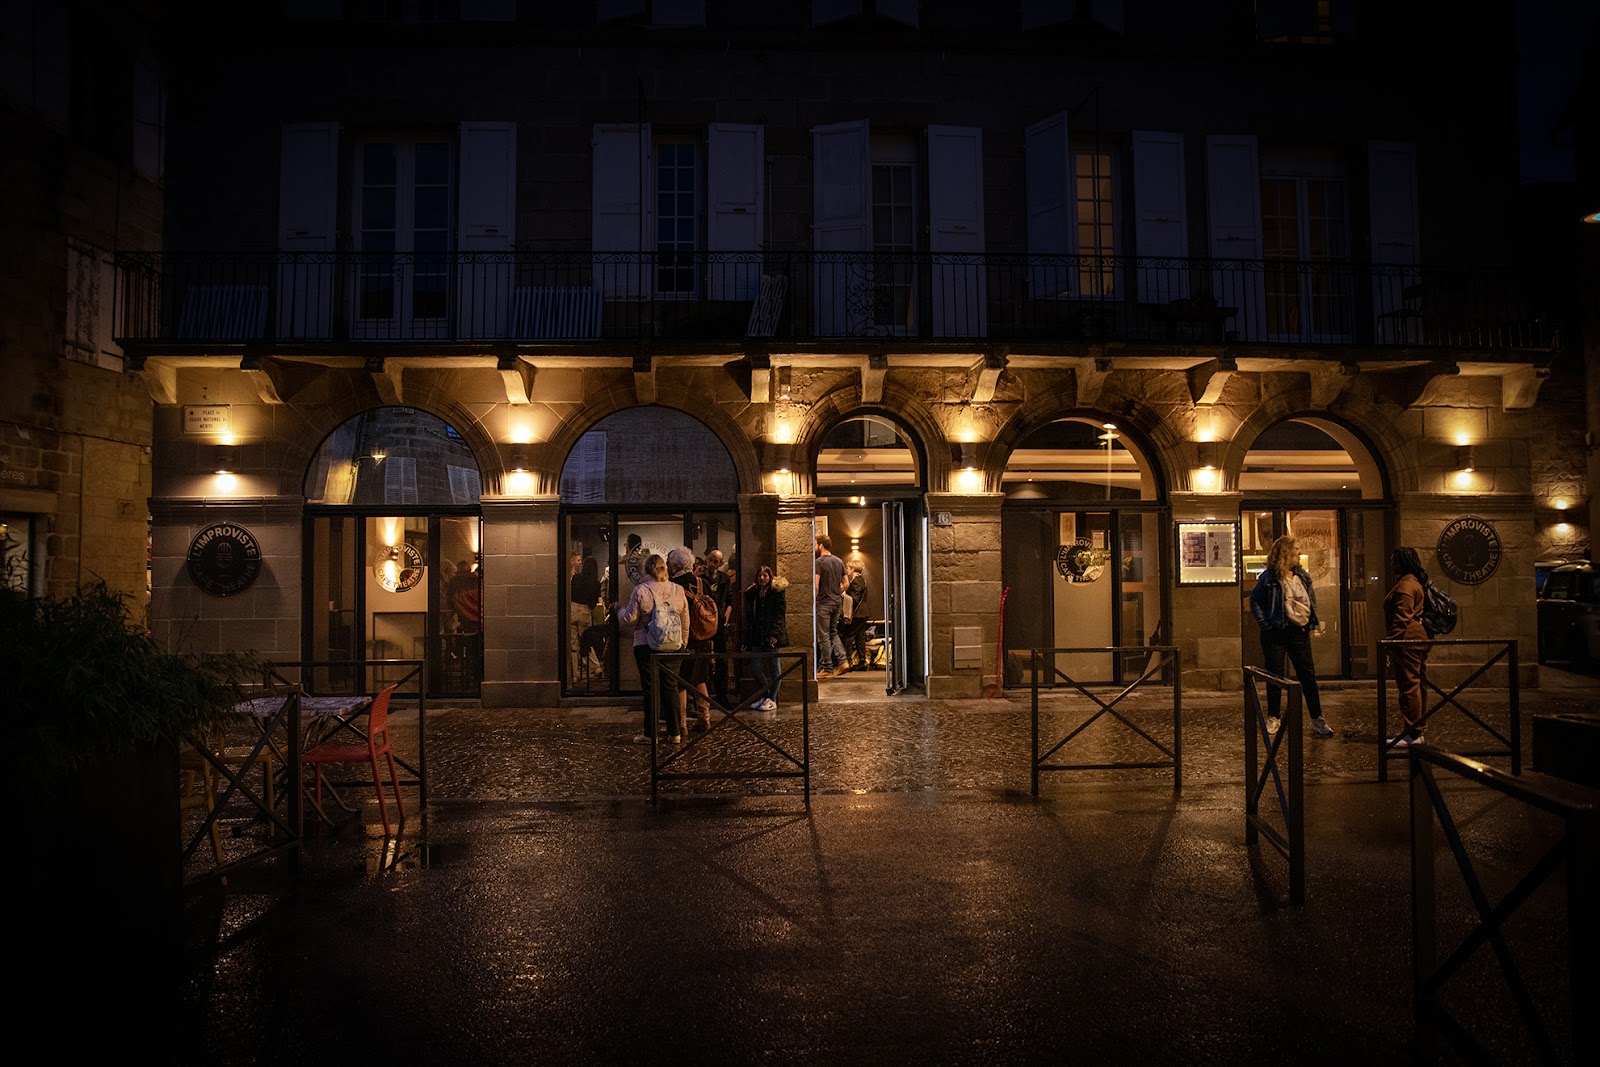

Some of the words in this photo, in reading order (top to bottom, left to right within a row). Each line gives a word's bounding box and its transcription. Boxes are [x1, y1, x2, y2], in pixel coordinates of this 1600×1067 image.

[937, 514, 948, 523] 16
[192, 526, 257, 558] L'IMPROVISTE
[1060, 539, 1097, 559] L'IMPROVI
[376, 545, 421, 566] 'IMPROVISTE
[1463, 553, 1498, 580] THEATRE
[378, 568, 392, 586] CAFE
